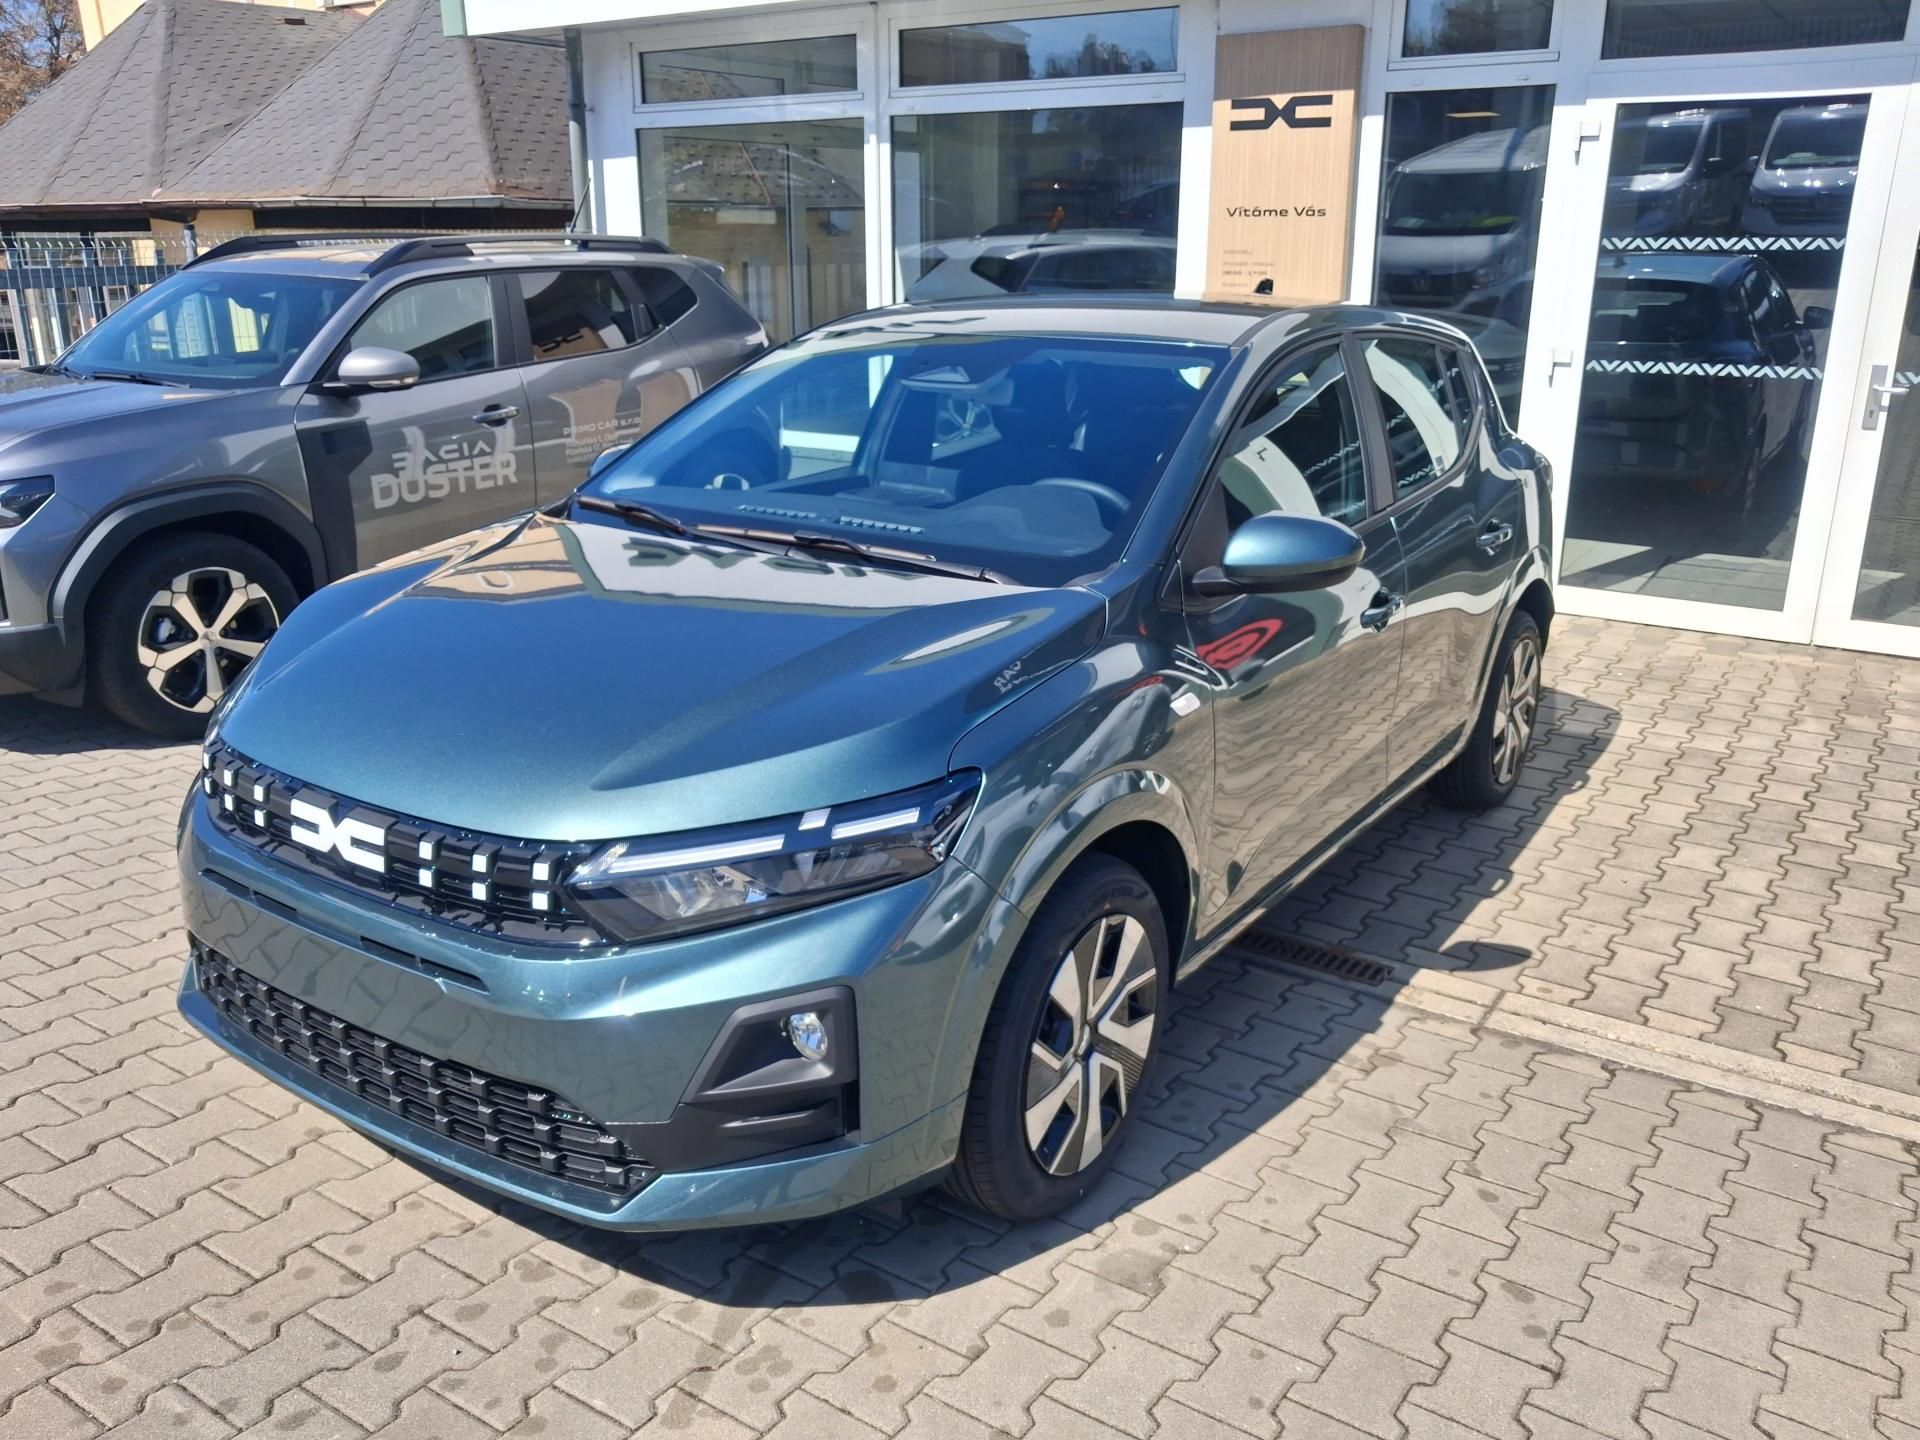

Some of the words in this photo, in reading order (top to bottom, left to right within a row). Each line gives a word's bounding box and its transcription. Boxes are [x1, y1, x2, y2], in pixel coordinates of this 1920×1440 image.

[1226, 206, 1288, 217] Vítáme
[1294, 205, 1326, 217] Vás
[597, 418, 618, 430] CAR
[370, 452, 518, 509] DUSTER
